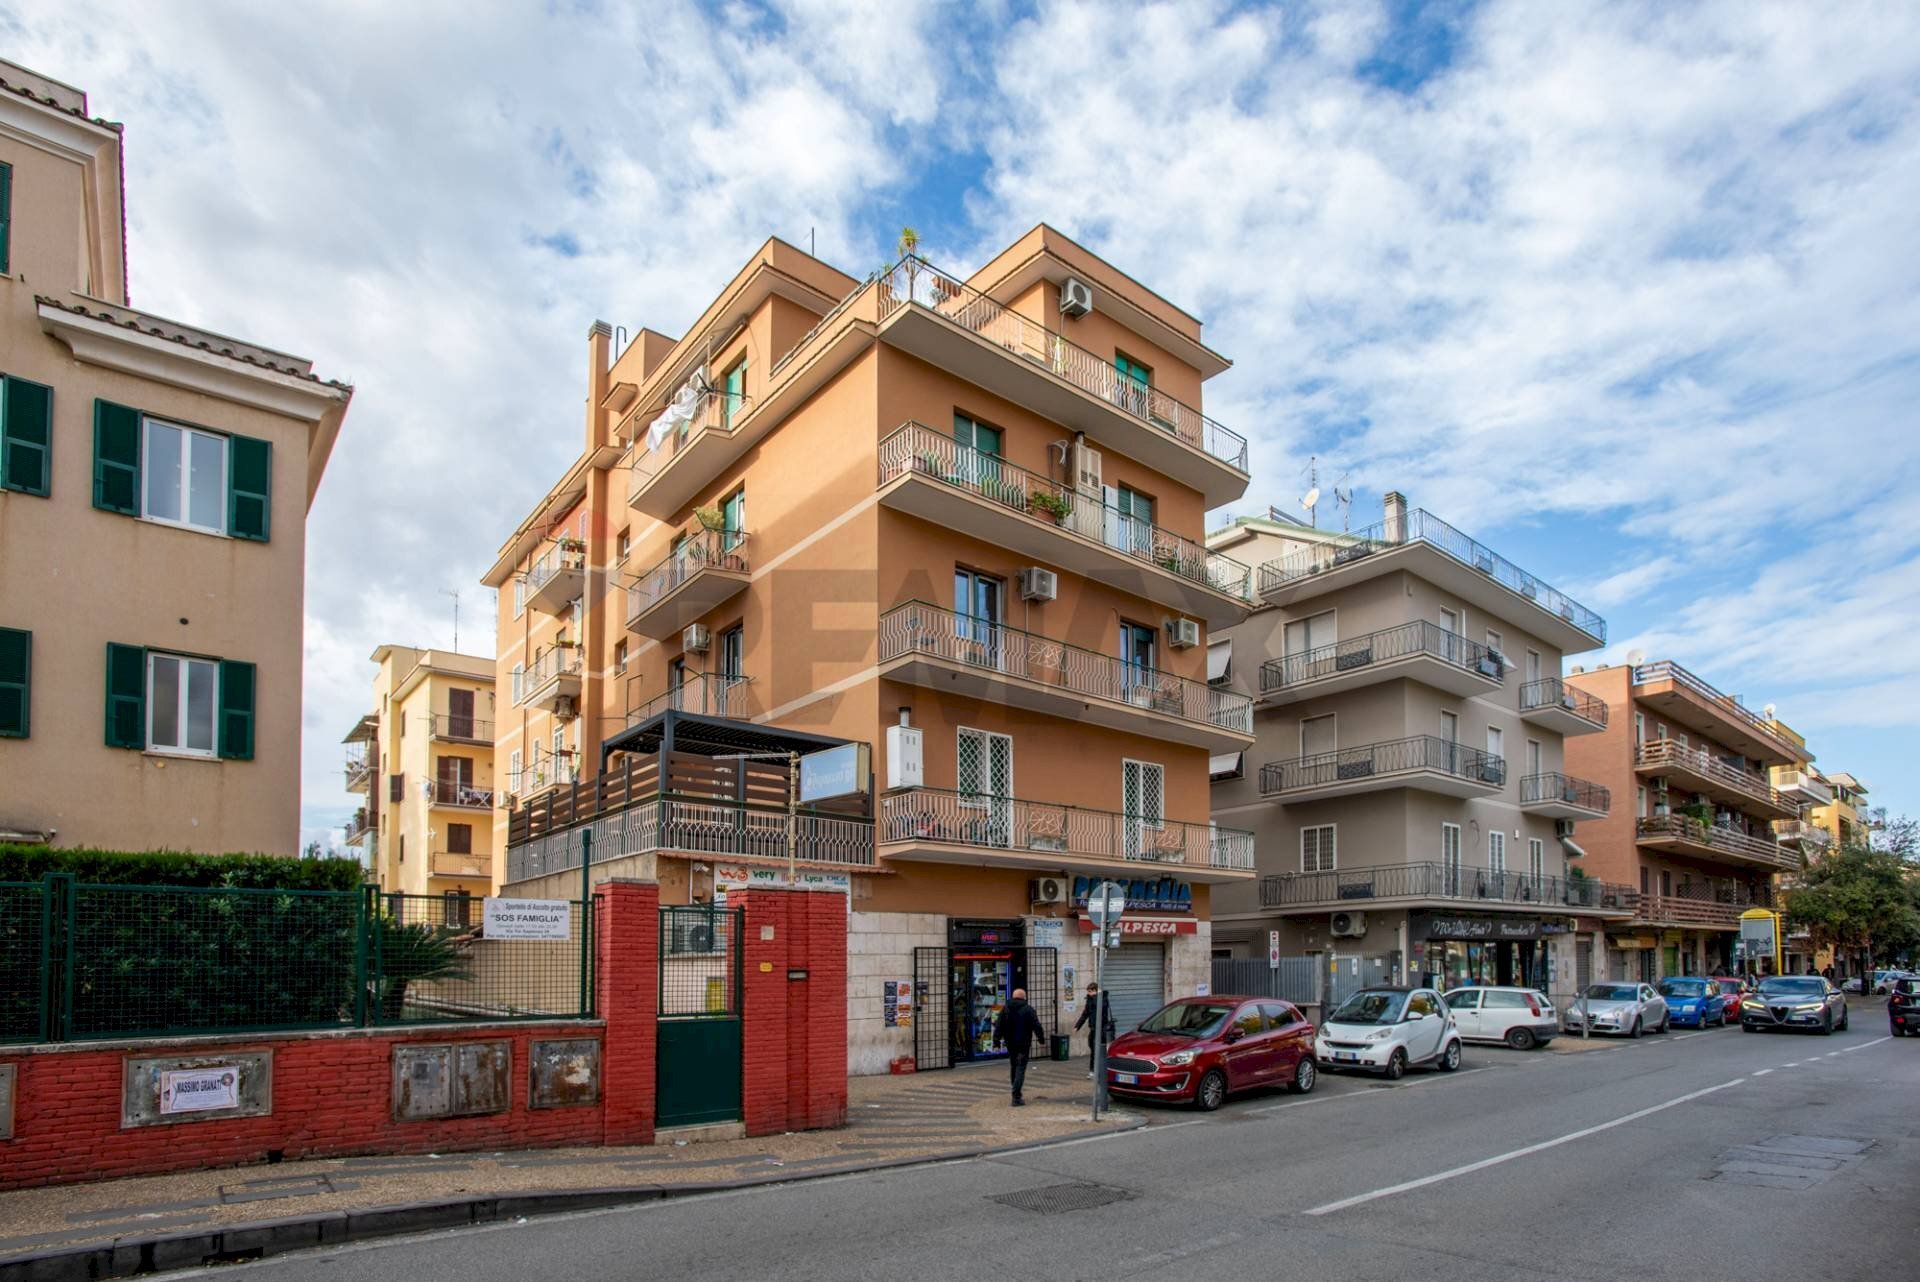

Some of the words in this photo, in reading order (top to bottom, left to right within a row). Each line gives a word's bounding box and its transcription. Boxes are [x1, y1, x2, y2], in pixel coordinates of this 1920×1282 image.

[753, 870, 775, 881] very
[804, 874, 823, 883] Lyca
[1112, 921, 1177, 934] ALPESCA
[176, 1080, 199, 1093] MASSIMO
